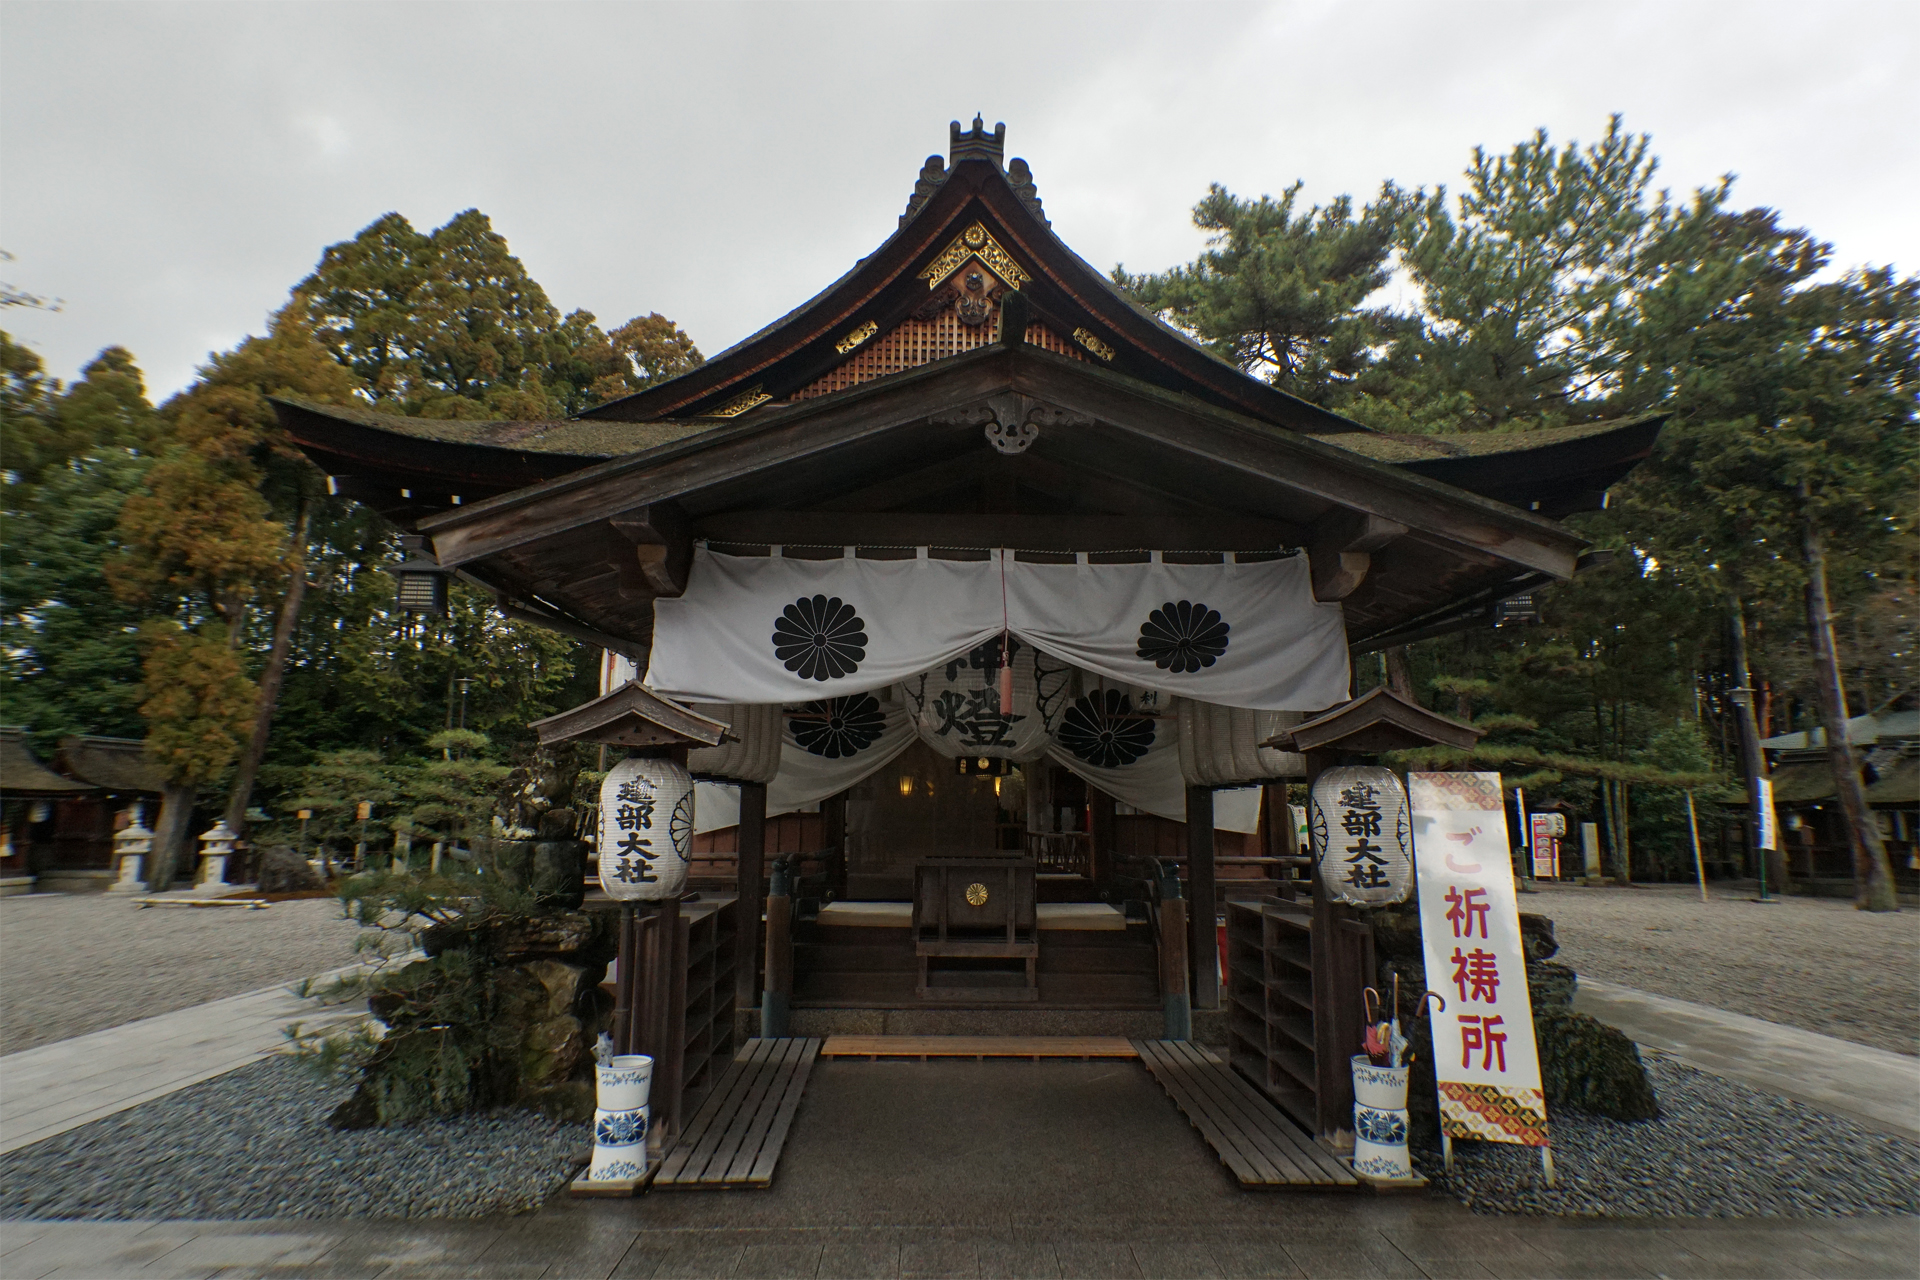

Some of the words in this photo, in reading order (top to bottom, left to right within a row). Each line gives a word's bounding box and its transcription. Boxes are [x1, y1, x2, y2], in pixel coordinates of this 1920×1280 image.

[612, 774, 661, 884] 建部大社
[1338, 781, 1391, 889] 建部大社
[1444, 826, 1508, 1073] ご祈祷所
